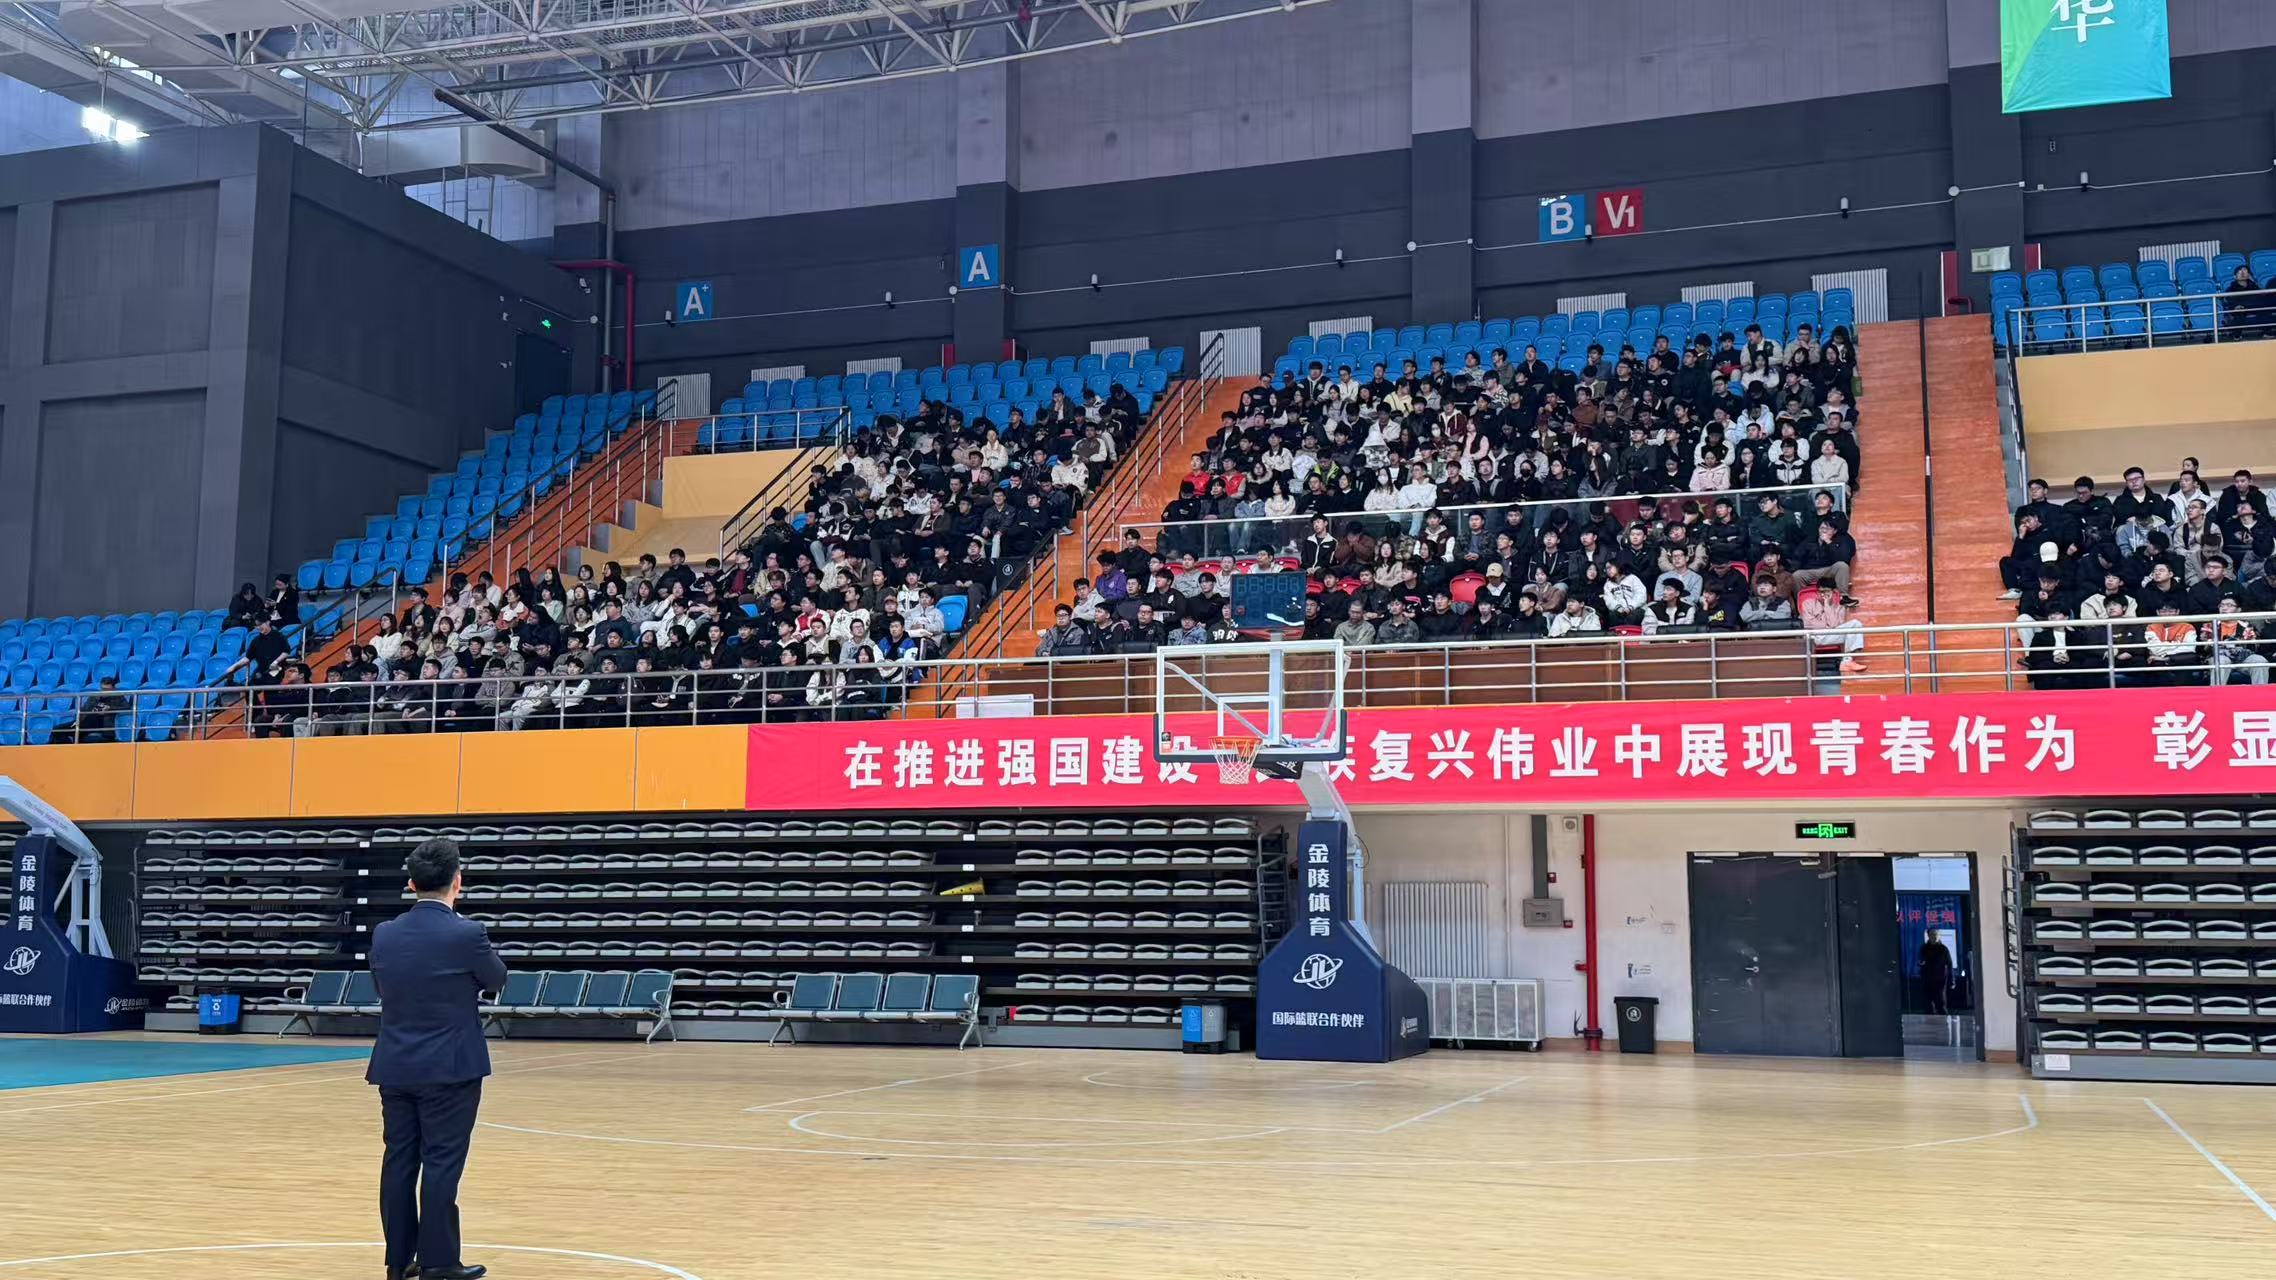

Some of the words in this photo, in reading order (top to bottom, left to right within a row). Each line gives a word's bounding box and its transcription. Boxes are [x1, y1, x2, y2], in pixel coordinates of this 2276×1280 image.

[1550, 202, 1575, 235] B
[1603, 195, 1635, 230] V1
[967, 251, 990, 282] A
[2151, 709, 2276, 771] 彰显
[17, 854, 38, 932] 金陵体育
[1307, 843, 1331, 937] 金陵体育
[1272, 1011, 1365, 1028] 国际篮联合作伙伴
